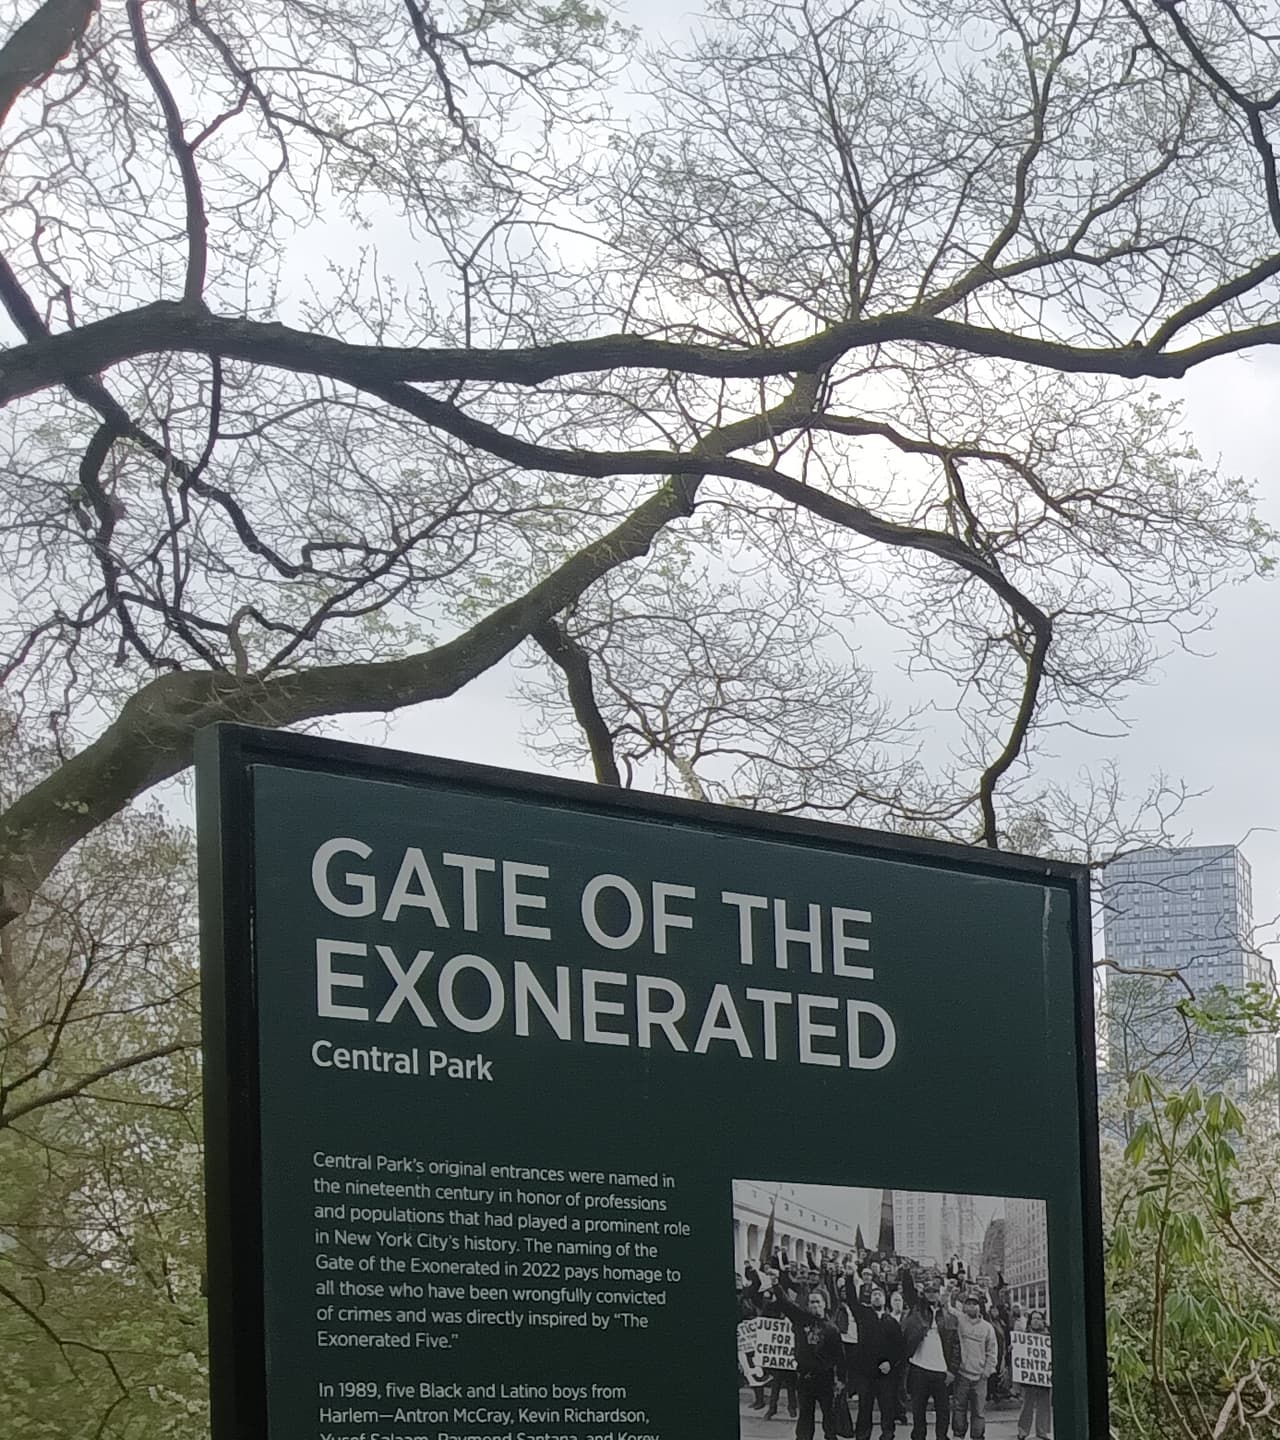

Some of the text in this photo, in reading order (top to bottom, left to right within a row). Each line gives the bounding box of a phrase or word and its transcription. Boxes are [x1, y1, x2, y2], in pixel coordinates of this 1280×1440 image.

[312, 838, 873, 979] GATE OF THE
[317, 939, 895, 1069] EXONERATED
[312, 1040, 493, 1080] Central Park
[313, 1177, 667, 1211] the nineteenth century in honor of professions
[314, 1204, 690, 1236] and populations that had played a prominent role
[316, 1254, 681, 1284] Gate of the Exonerated in 2022 pays homage to
[315, 1280, 666, 1305] all those who have been wrongfully convicted
[757, 1320, 790, 1333] JUSTI
[771, 1333, 791, 1345] FOR
[1012, 1333, 1051, 1348] JUSTIC
[1027, 1347, 1047, 1359] FOR
[319, 1382, 626, 1401] In 1989, five Black and Latino boys from
